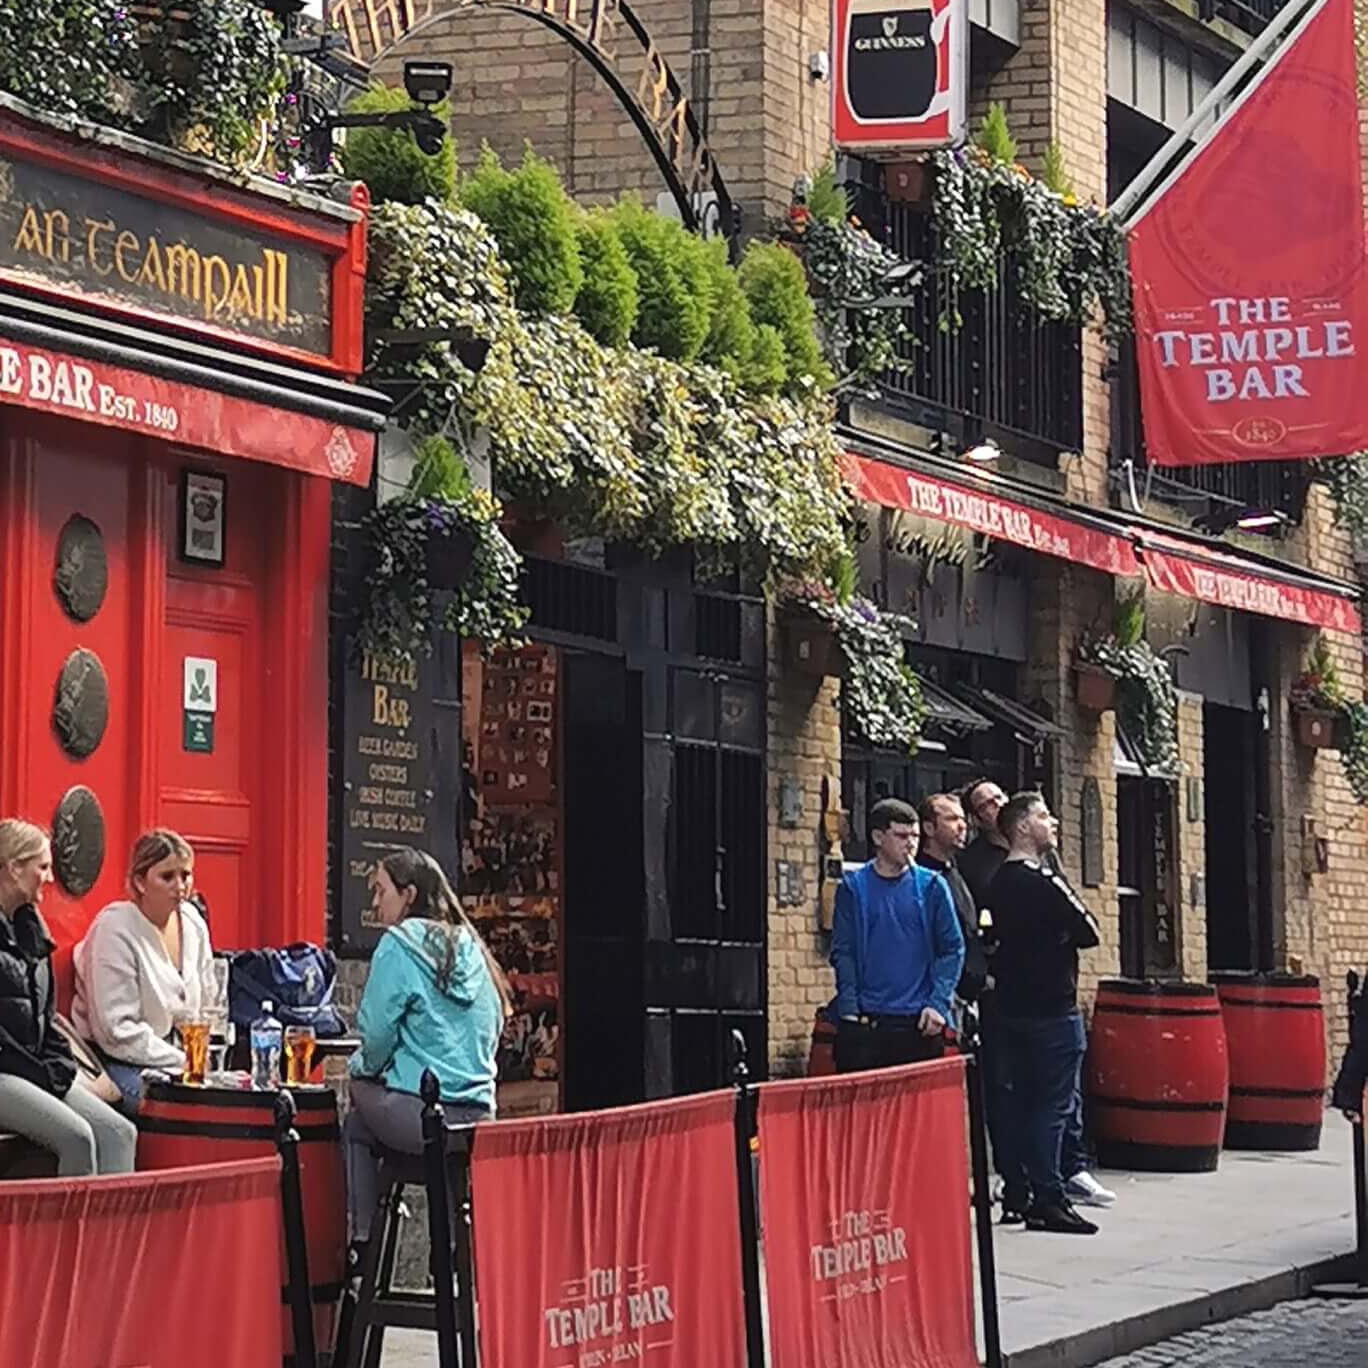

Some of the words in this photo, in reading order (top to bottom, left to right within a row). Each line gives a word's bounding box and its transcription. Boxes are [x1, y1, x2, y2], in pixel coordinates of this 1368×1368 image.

[1211, 297, 1292, 327] THE
[1153, 320, 1356, 368] TEMPLE
[28, 354, 98, 415] BAR
[143, 400, 179, 432] 1840
[1205, 363, 1311, 402] BAR
[907, 476, 943, 515] THE
[941, 487, 1003, 533] TEMPLE
[372, 683, 410, 728] BAR
